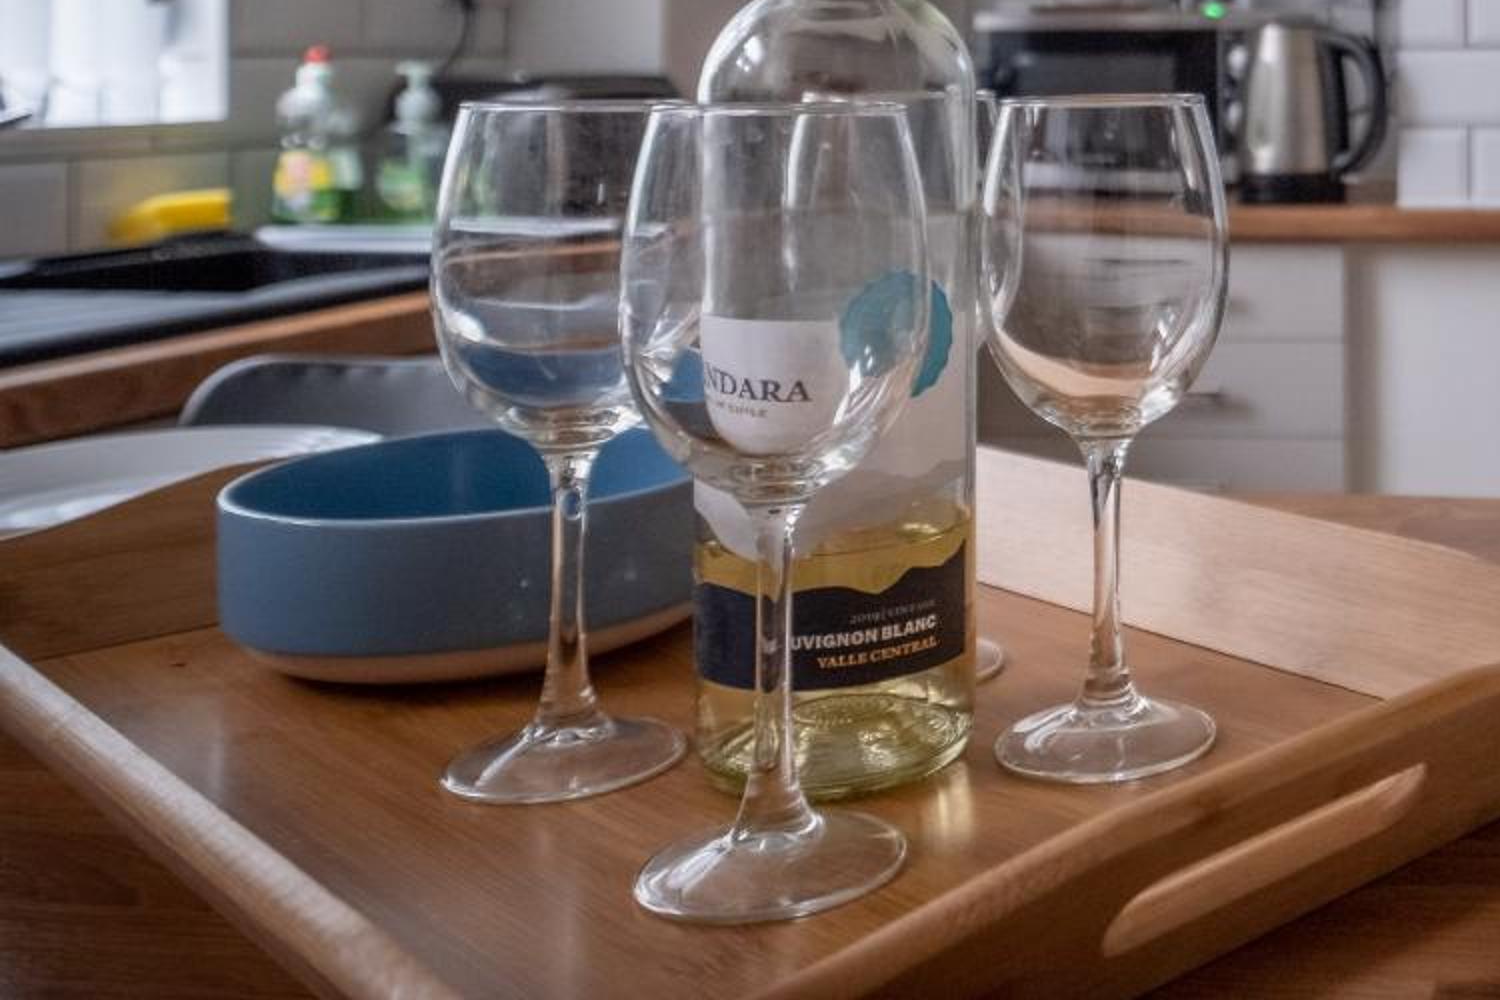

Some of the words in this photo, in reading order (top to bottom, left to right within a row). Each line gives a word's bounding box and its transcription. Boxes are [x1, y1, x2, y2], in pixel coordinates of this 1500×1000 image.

[791, 628, 877, 650] UVIGNON
[882, 614, 937, 639] BLANC
[817, 652, 867, 669] VALLE
[870, 635, 938, 663] CENTRAL
